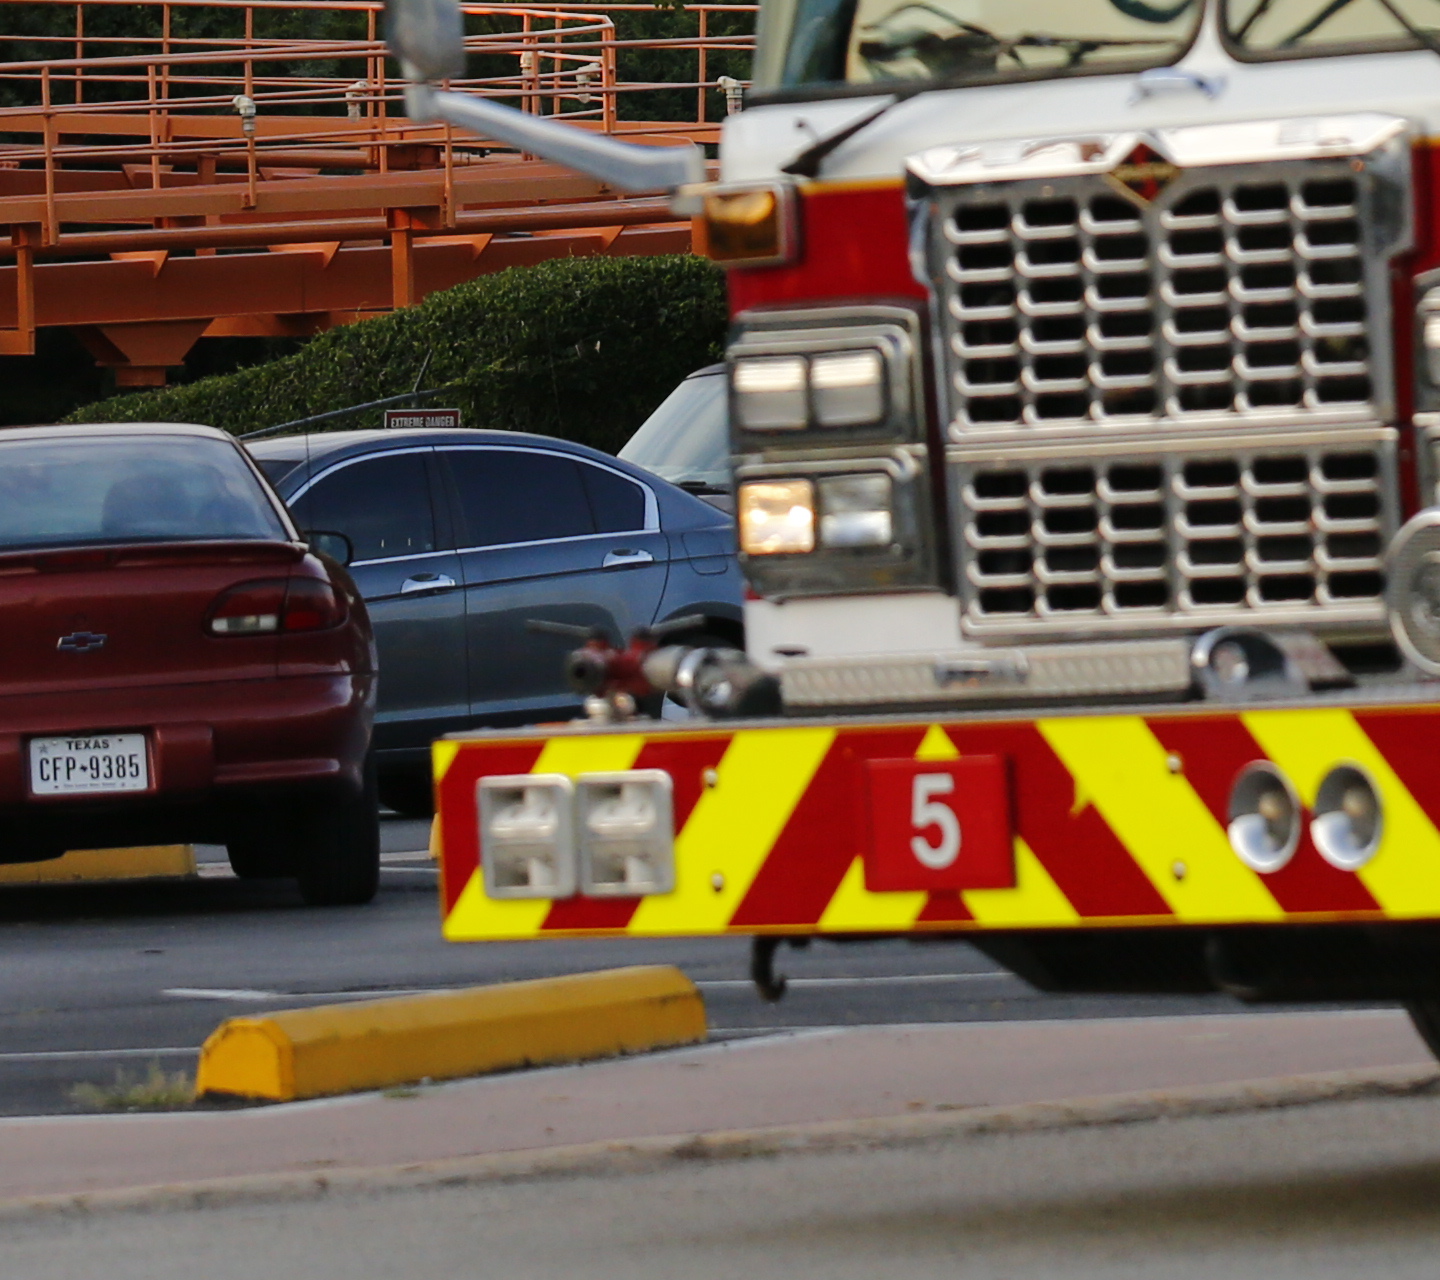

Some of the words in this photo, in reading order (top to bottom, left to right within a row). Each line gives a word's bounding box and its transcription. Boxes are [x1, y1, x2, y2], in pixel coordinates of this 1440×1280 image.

[390, 417, 424, 428] EXTREME
[425, 416, 455, 428] DANGER
[66, 739, 110, 751] TEXAS
[910, 772, 962, 870] 5
